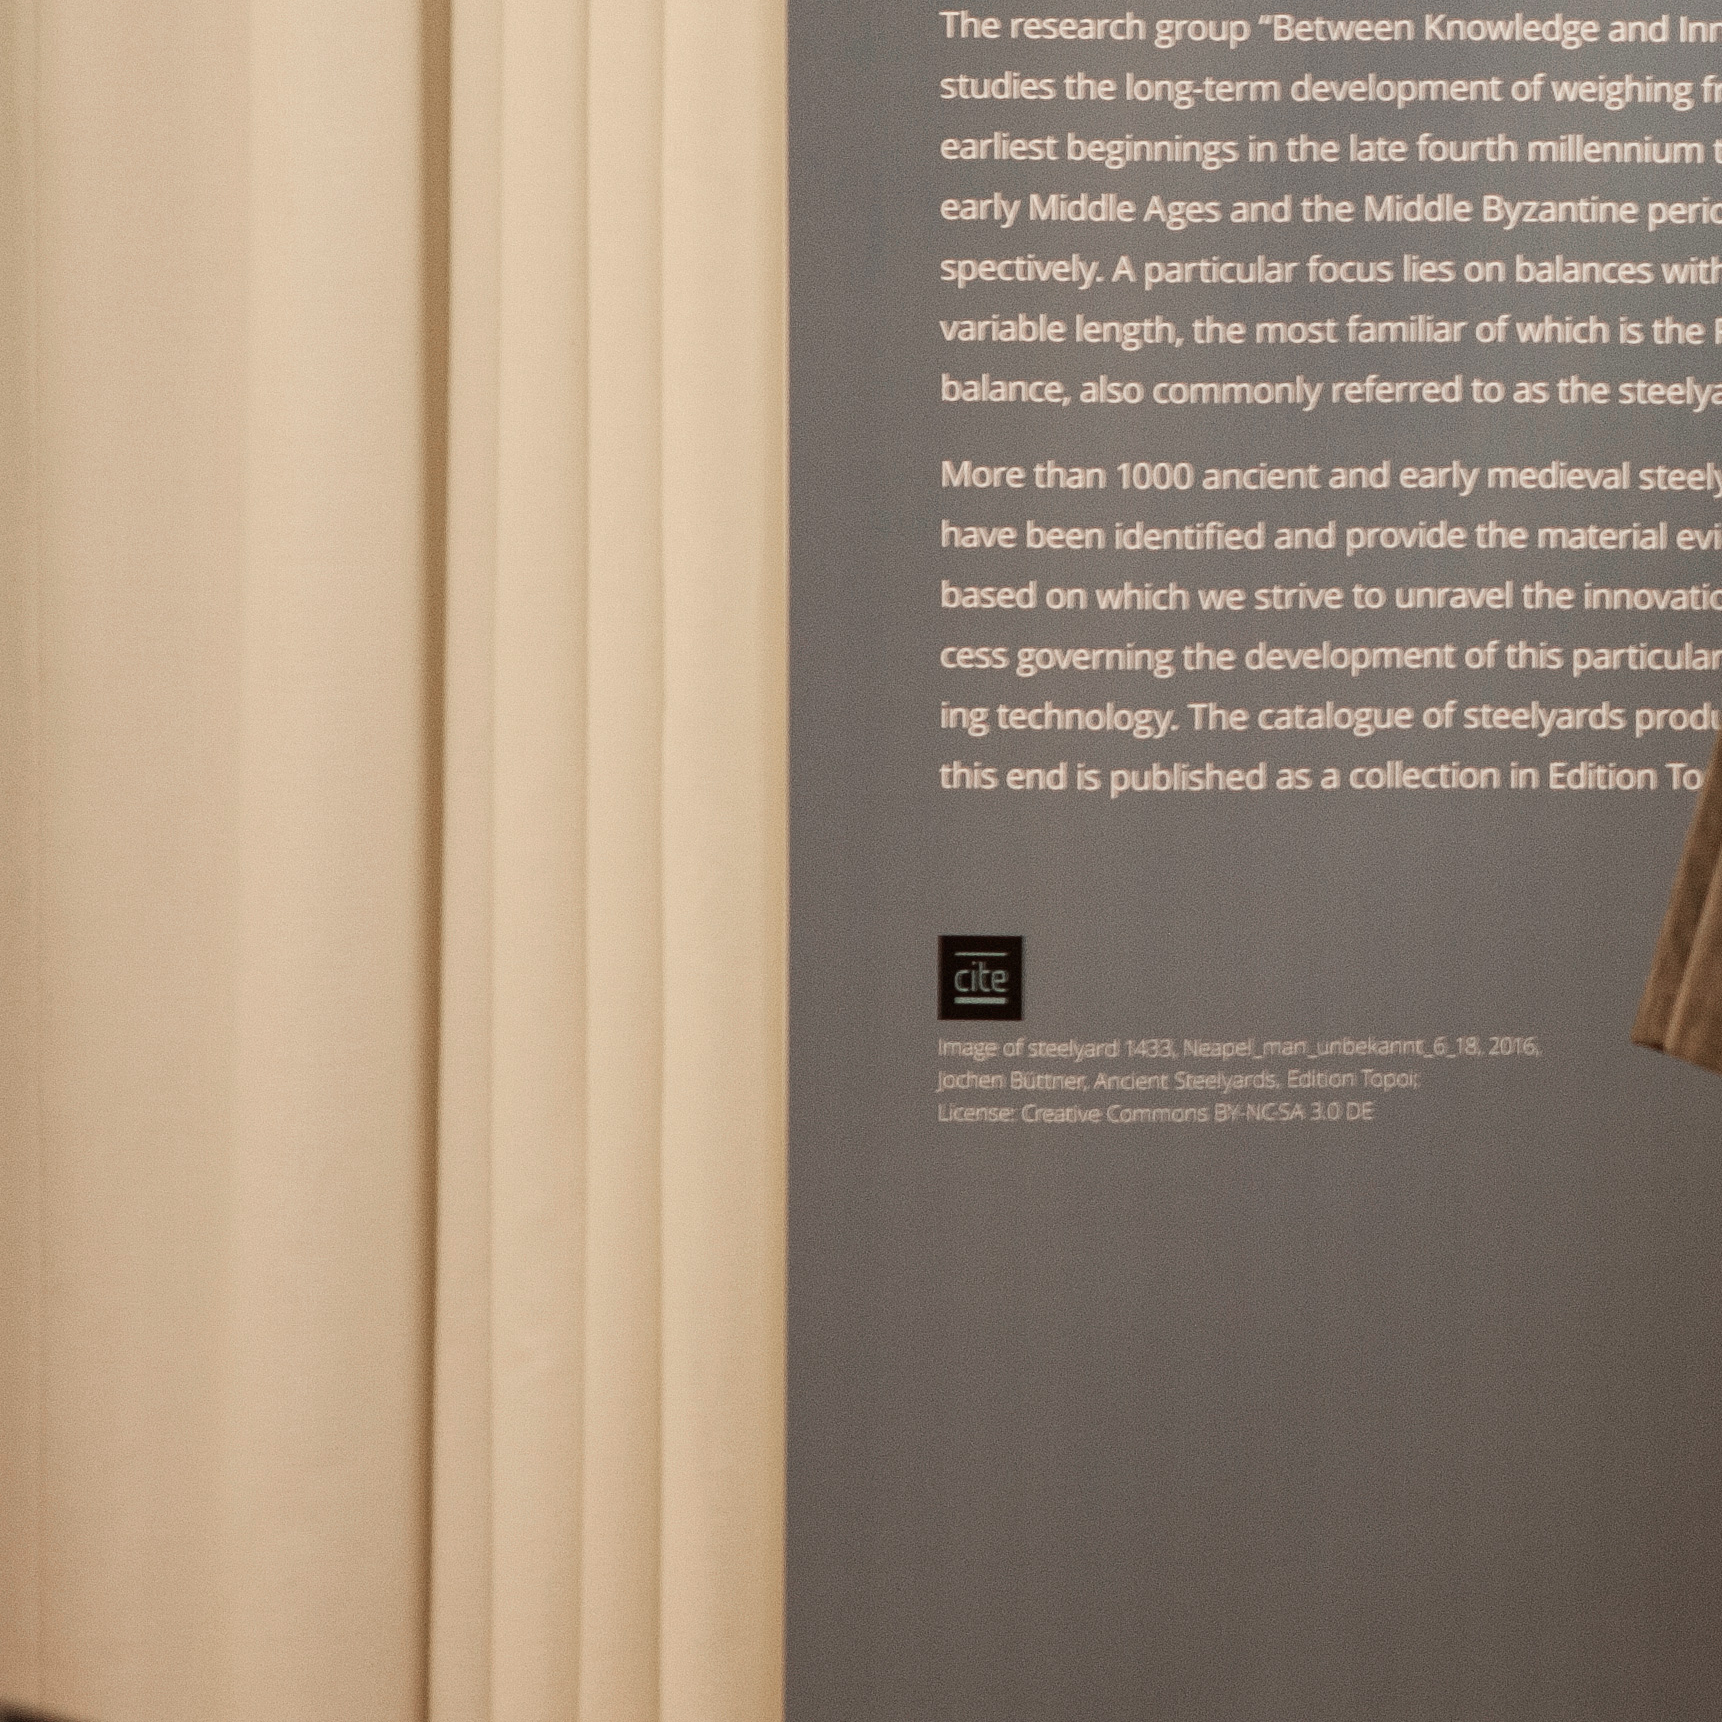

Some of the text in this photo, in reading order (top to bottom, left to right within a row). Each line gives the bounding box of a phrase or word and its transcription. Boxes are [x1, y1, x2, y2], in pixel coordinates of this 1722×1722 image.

[940, 9, 1003, 40] The
[1011, 11, 1148, 42] research
[1154, 18, 1252, 50] group
[1425, 12, 1602, 51] Knowledge
[1608, 14, 1671, 44] and
[941, 70, 1058, 101] studies
[1064, 71, 1118, 102] the
[1126, 72, 1283, 111] long-term
[1290, 72, 1504, 110] development
[1511, 72, 1546, 103] of
[1551, 73, 1696, 113] weighing
[940, 131, 1059, 162] earliest
[1067, 132, 1241, 172] beginnings
[1248, 134, 1279, 163] in
[1287, 133, 1342, 164] the
[1350, 133, 1410, 163] late
[1417, 131, 1520, 163] fourth
[1528, 133, 1706, 165] millennium
[940, 191, 1022, 230] early
[1029, 192, 1138, 223] Middle
[1144, 195, 1223, 232] Ages
[1230, 194, 1293, 224] and
[1301, 194, 1357, 224] the
[1365, 193, 1475, 223] Middle
[1483, 193, 1641, 231] Byzantine
[941, 253, 1105, 291] spectively.
[1112, 255, 1138, 283] A
[1145, 254, 1299, 291] particular
[1307, 253, 1395, 284] focus
[1403, 253, 1457, 284] lies
[1464, 260, 1507, 284] on
[1515, 254, 1656, 285] balances
[940, 313, 1068, 344] variable
[1076, 313, 1185, 353] length,
[1193, 315, 1248, 345] the
[1256, 318, 1339, 345] most
[1347, 313, 1469, 344] familiar
[1475, 313, 1511, 344] of
[1516, 314, 1611, 345] which
[1619, 316, 1646, 346] is
[1652, 315, 1707, 346] the
[941, 372, 1072, 407] balance,
[1080, 374, 1146, 405] also
[1153, 375, 1325, 413] commonly
[1332, 373, 1464, 405] referred
[1471, 378, 1507, 404] to
[1513, 380, 1551, 405] as
[1557, 374, 1612, 405] the
[942, 459, 1027, 489] More
[1034, 459, 1108, 490] than
[1118, 461, 1196, 491] 1000
[1202, 462, 1321, 491] ancient
[1329, 460, 1392, 490] and
[1399, 459, 1481, 497] early
[1488, 460, 1632, 491] medieval
[941, 519, 1019, 550] have
[1026, 519, 1107, 551] been
[1115, 520, 1267, 551] identified
[1274, 520, 1337, 551] and
[1346, 520, 1469, 557] provide
[1475, 520, 1530, 550] the
[1538, 521, 1669, 551] material
[941, 579, 1039, 610] based
[1046, 586, 1089, 611] on
[1096, 581, 1191, 612] which
[1198, 588, 1247, 612] we
[1255, 582, 1346, 611] strive
[1352, 584, 1388, 610] to
[1395, 580, 1515, 610] unravel
[1522, 580, 1577, 611] the
[940, 646, 1011, 670] cess
[1016, 642, 1176, 680] governing
[1183, 642, 1238, 672] the
[1245, 640, 1457, 677] development
[1465, 639, 1500, 670] of
[1505, 640, 1565, 671] this
[941, 701, 991, 738] ing
[997, 701, 1180, 740] technology.
[1188, 701, 1251, 732] The
[1258, 700, 1416, 738] catalogue
[1422, 699, 1458, 730] of
[1464, 700, 1628, 738] steelyards
[940, 760, 1000, 791] this
[1006, 761, 1069, 792] end
[1077, 762, 1103, 792] is
[1110, 761, 1268, 799] published
[1276, 767, 1314, 791] as
[1321, 767, 1342, 791] a
[1349, 760, 1502, 790] collection
[1510, 761, 1541, 789] in
[1549, 760, 1659, 791] Edition
[954, 961, 1008, 993] cite
[938, 1038, 998, 1062] Image
[1002, 1037, 1026, 1057] of
[1029, 1038, 1121, 1063] steelyard
[936, 1071, 1005, 1093] Jochen
[1093, 1071, 1170, 1090] Ancient
[1287, 1068, 1357, 1090] Edition
[1022, 1103, 1104, 1124] Creative
[1106, 1104, 1209, 1124] Commons
[1346, 1100, 1375, 1121] DE
